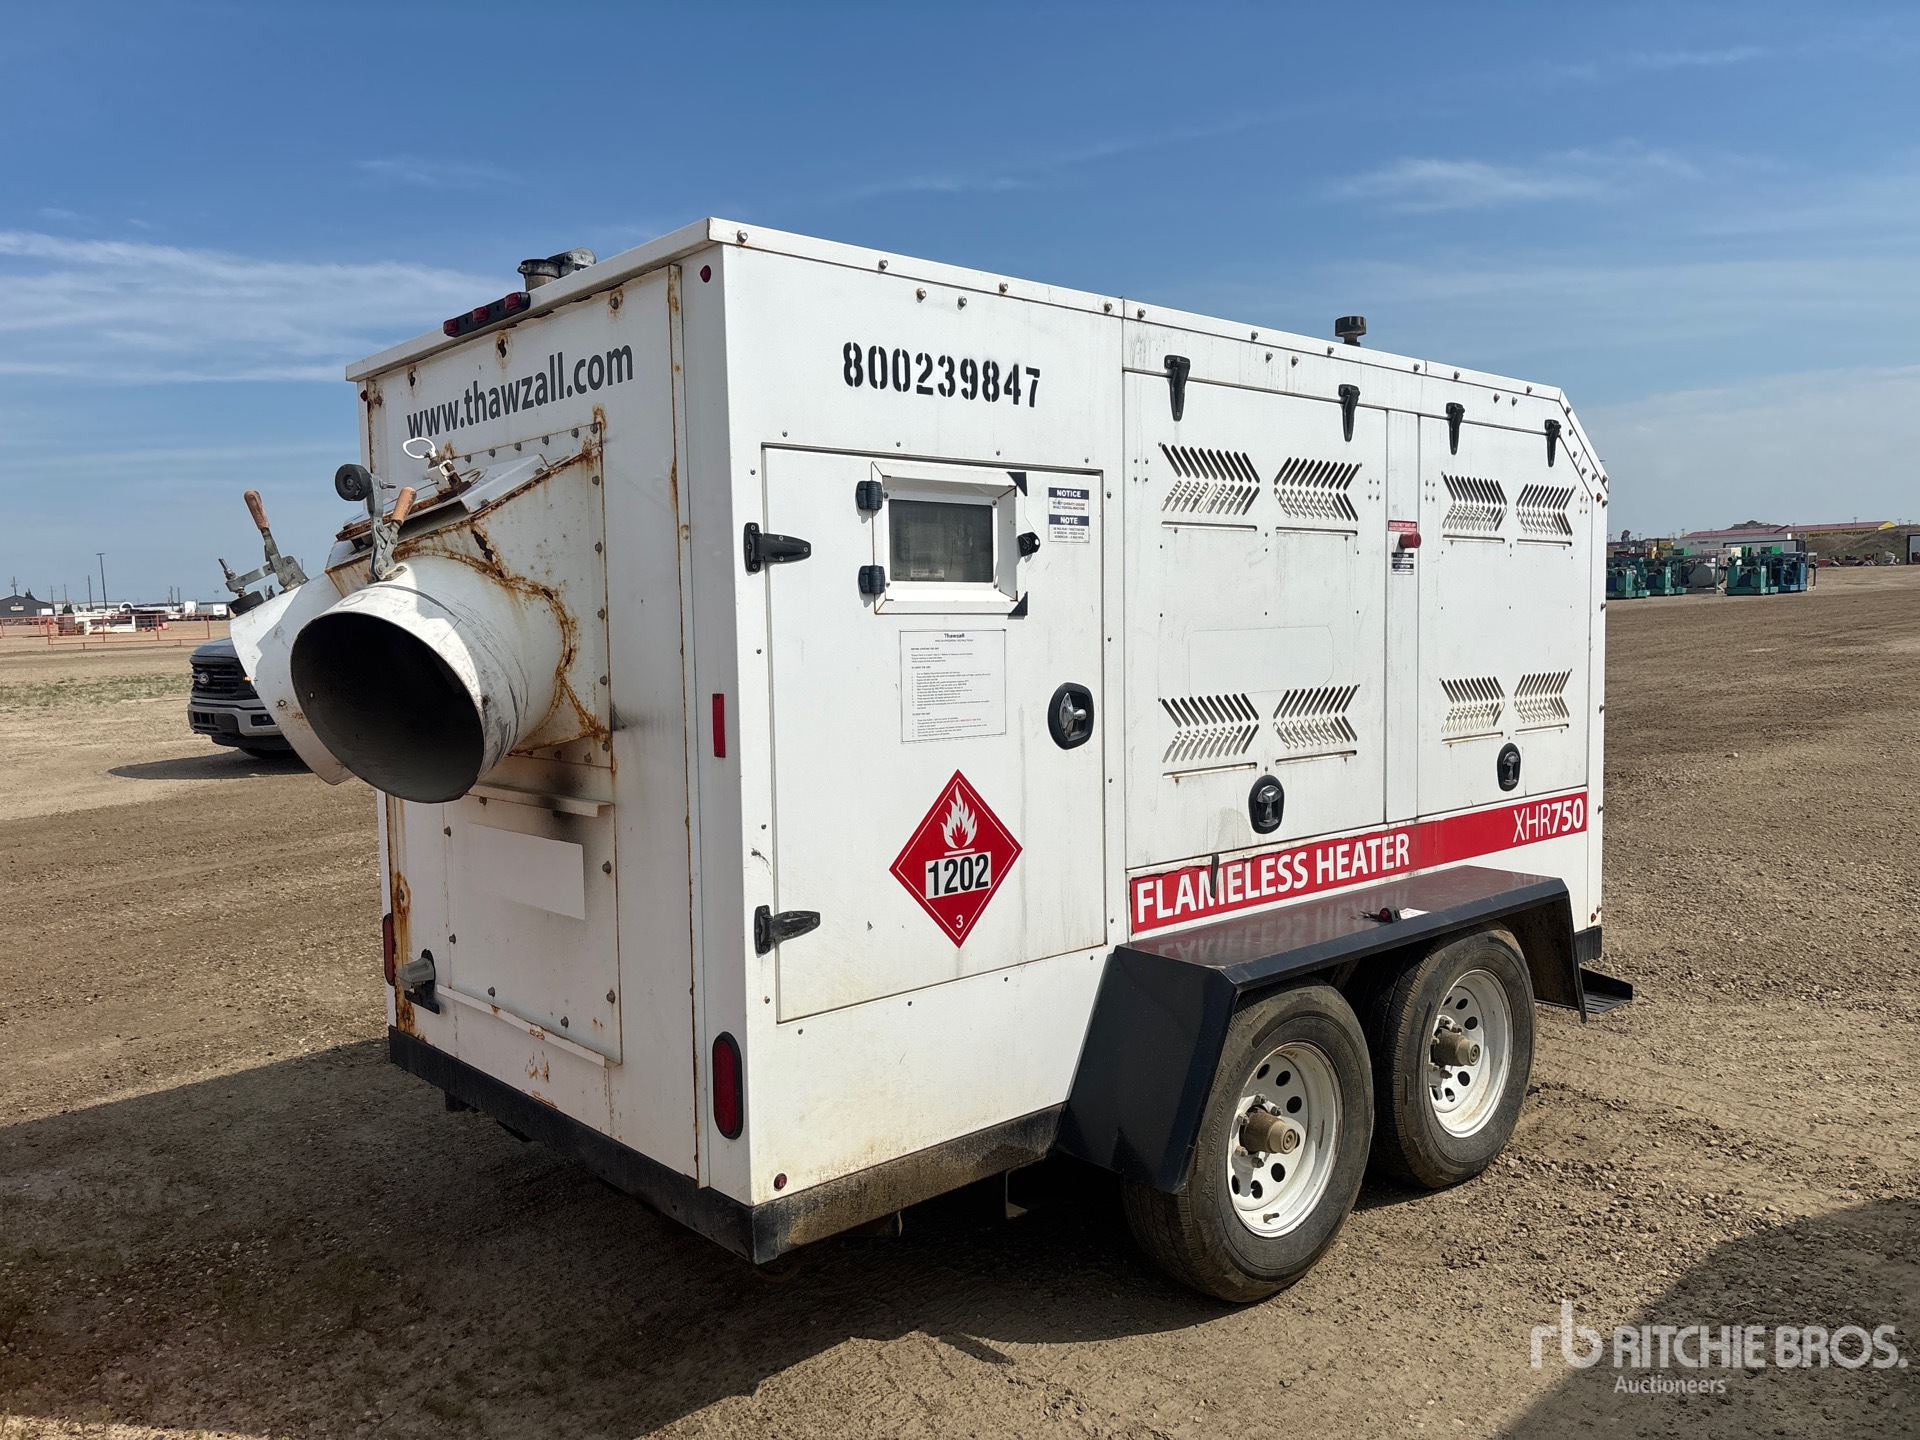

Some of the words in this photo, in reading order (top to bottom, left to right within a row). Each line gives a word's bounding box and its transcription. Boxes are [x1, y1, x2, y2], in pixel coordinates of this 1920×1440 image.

[407, 344, 633, 439] www.thawzall.com
[843, 341, 1040, 408] 800239847
[1056, 489, 1082, 498] NOTICE
[1060, 516, 1079, 525] NOTE
[1513, 797, 1584, 843] XHR750
[927, 853, 989, 896] 1202
[1137, 851, 1309, 923] FLAMELESS
[1316, 833, 1410, 885] HEATER
[955, 914, 964, 929] 3
